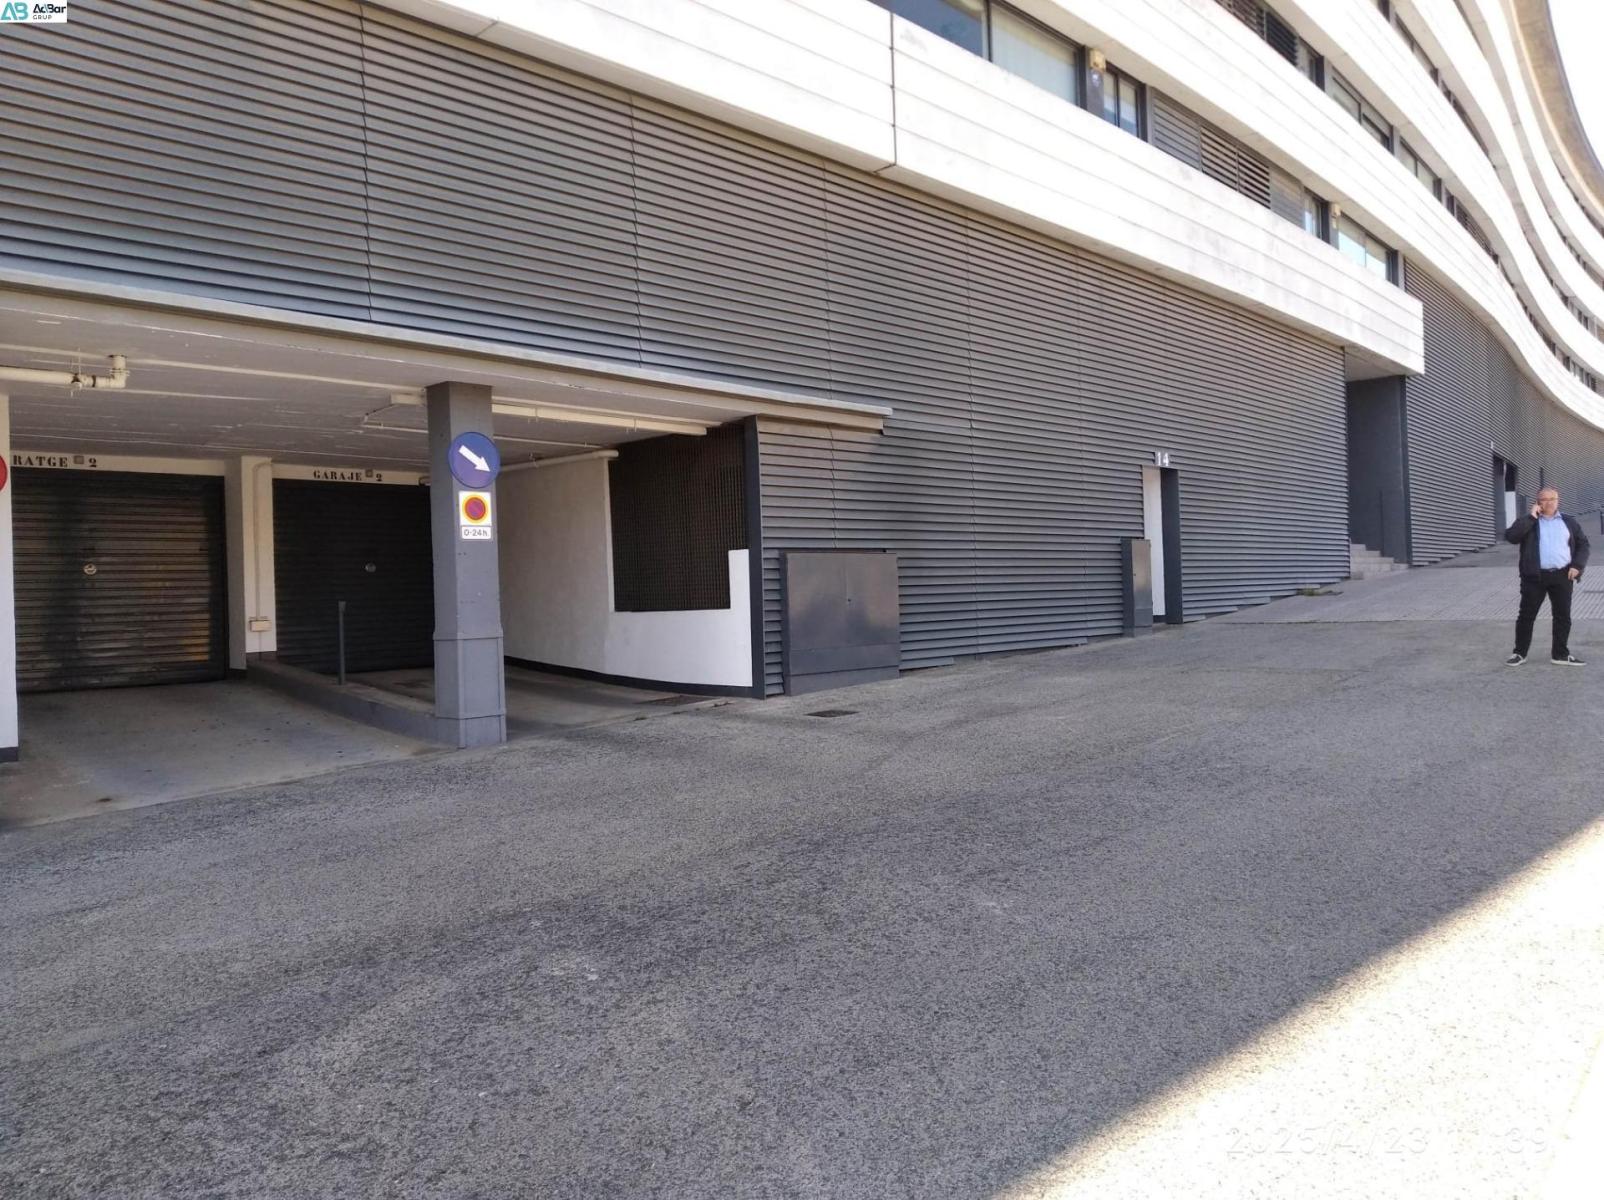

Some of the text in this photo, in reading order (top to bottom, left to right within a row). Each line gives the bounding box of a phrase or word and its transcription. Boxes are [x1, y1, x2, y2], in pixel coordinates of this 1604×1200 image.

[12, 454, 97, 468] RATGE 2
[1157, 451, 1169, 467] 14
[313, 469, 383, 482] GARAJE 2
